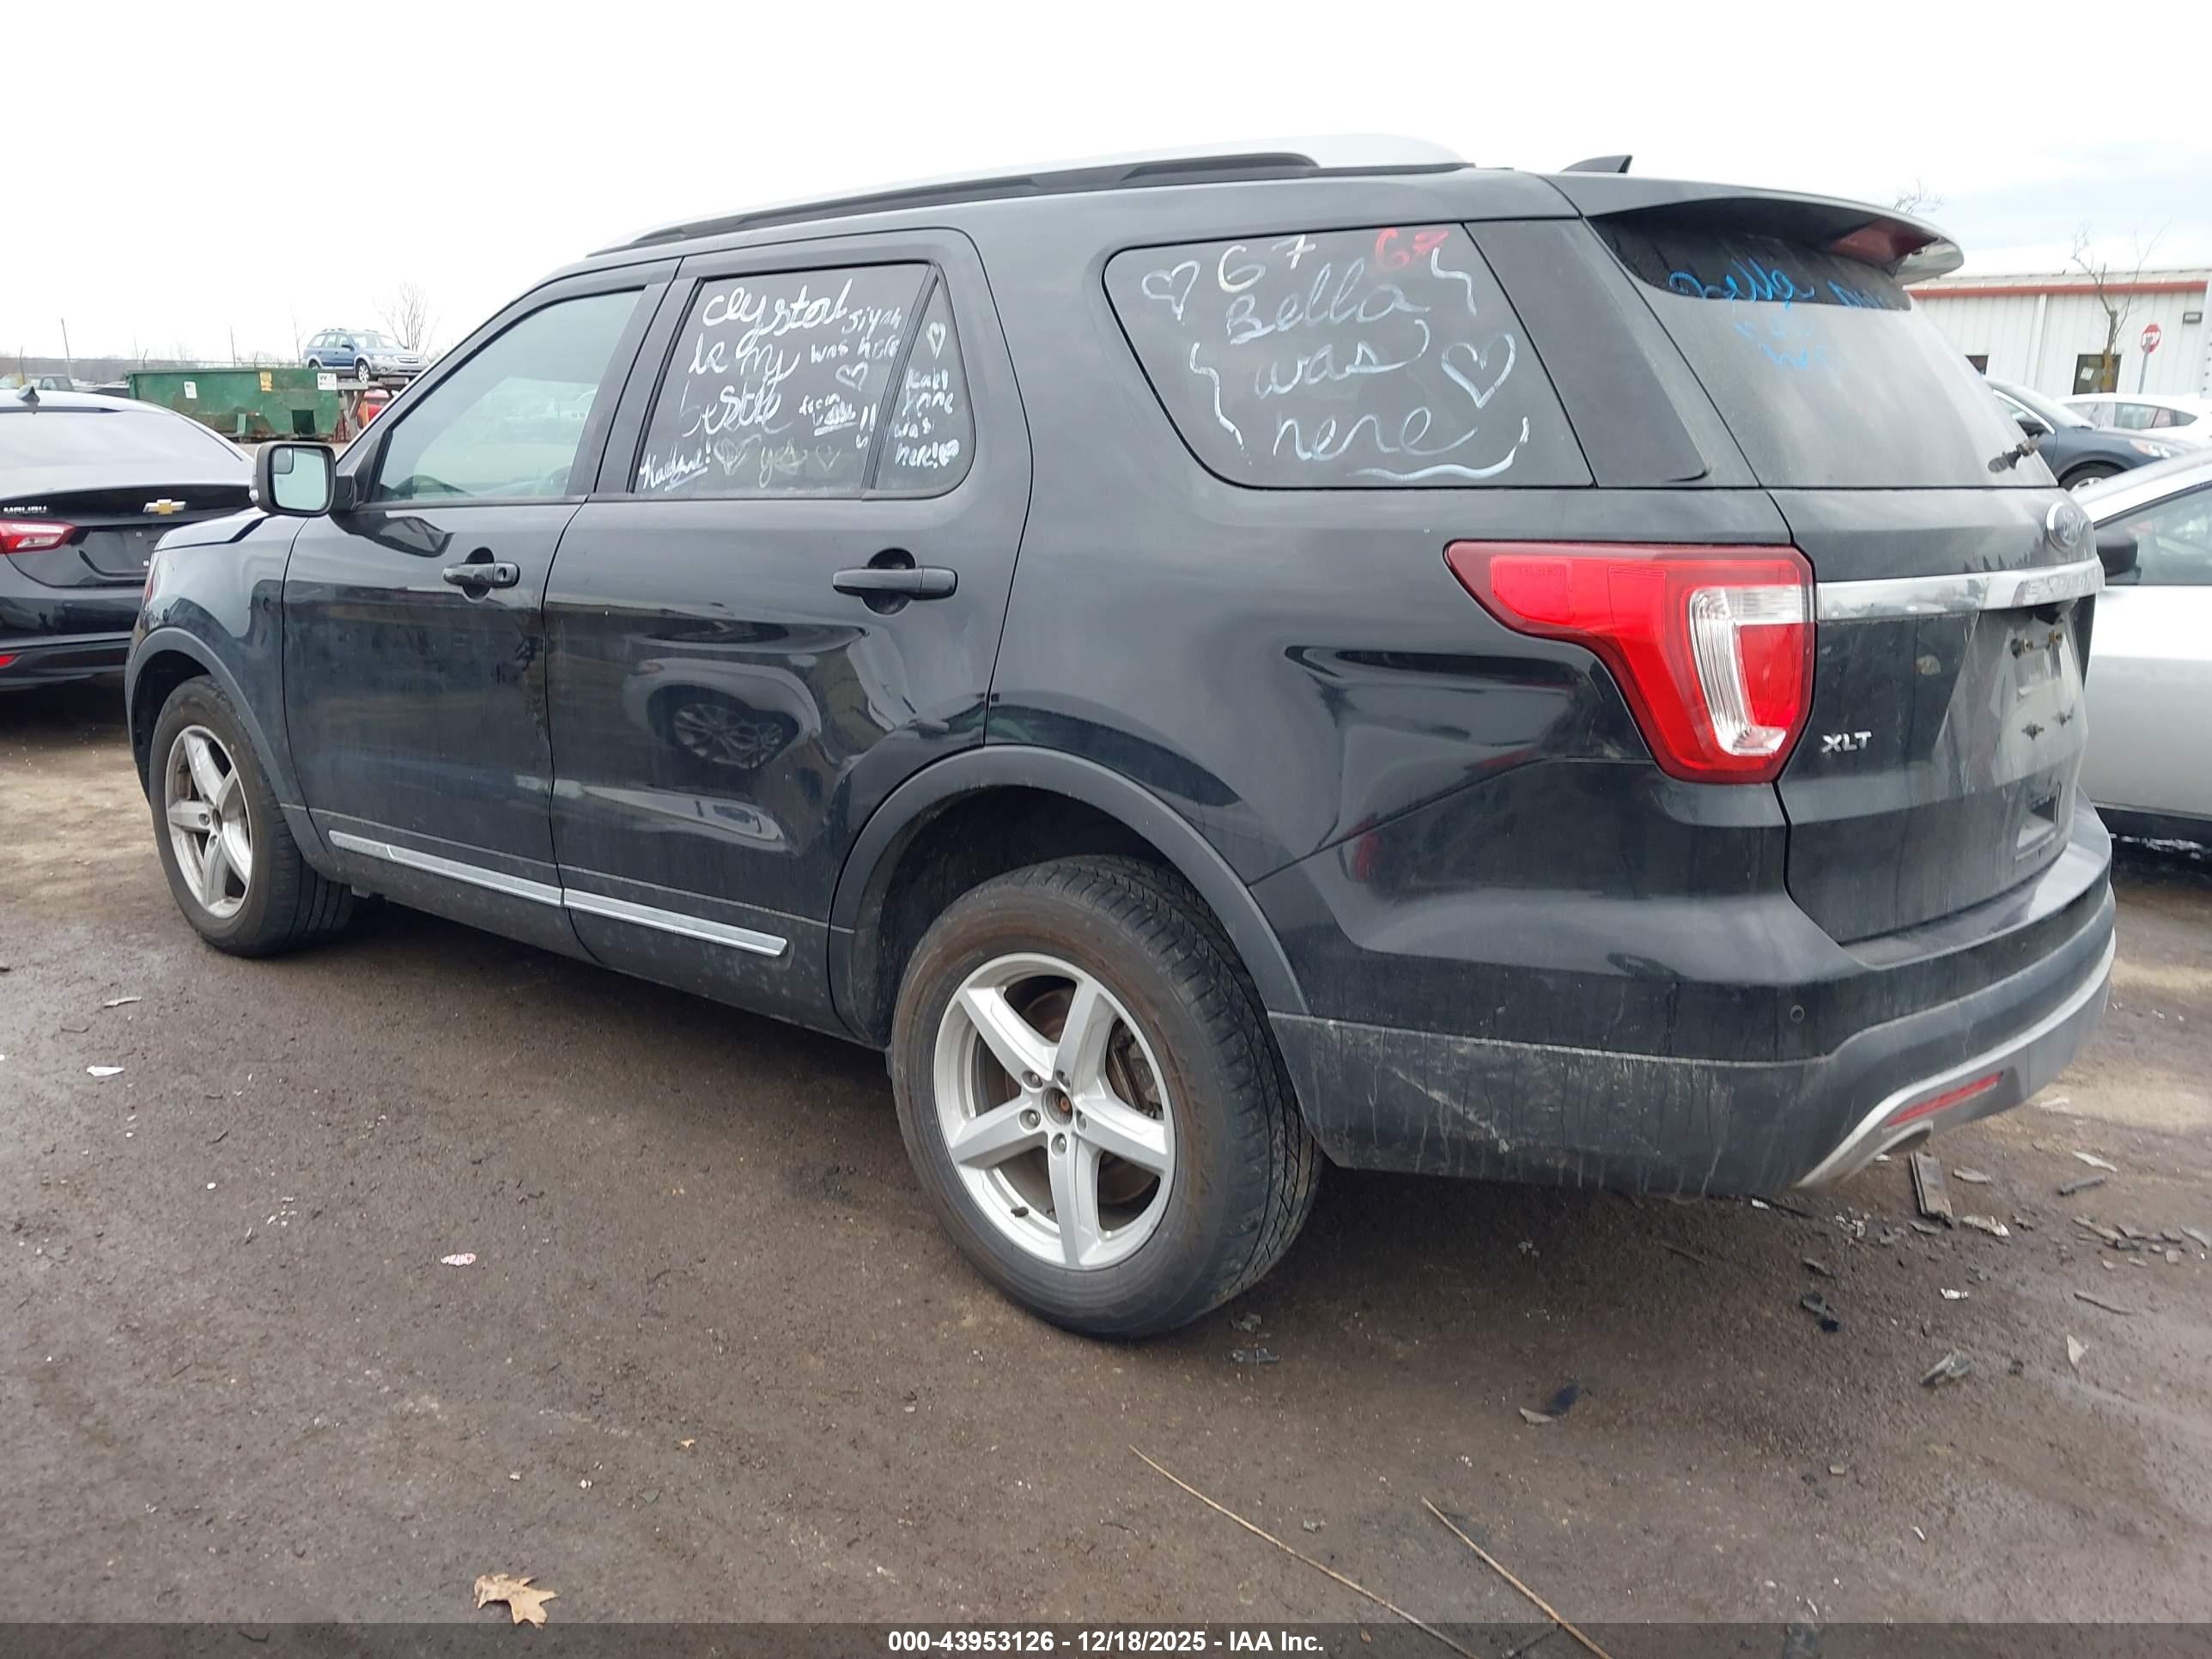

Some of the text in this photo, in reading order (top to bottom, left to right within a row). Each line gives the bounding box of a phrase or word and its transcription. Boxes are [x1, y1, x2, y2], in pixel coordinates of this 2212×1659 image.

[1227, 259, 1431, 344] Bella
[1255, 319, 1431, 398] was
[1821, 731, 1872, 753] XLT
